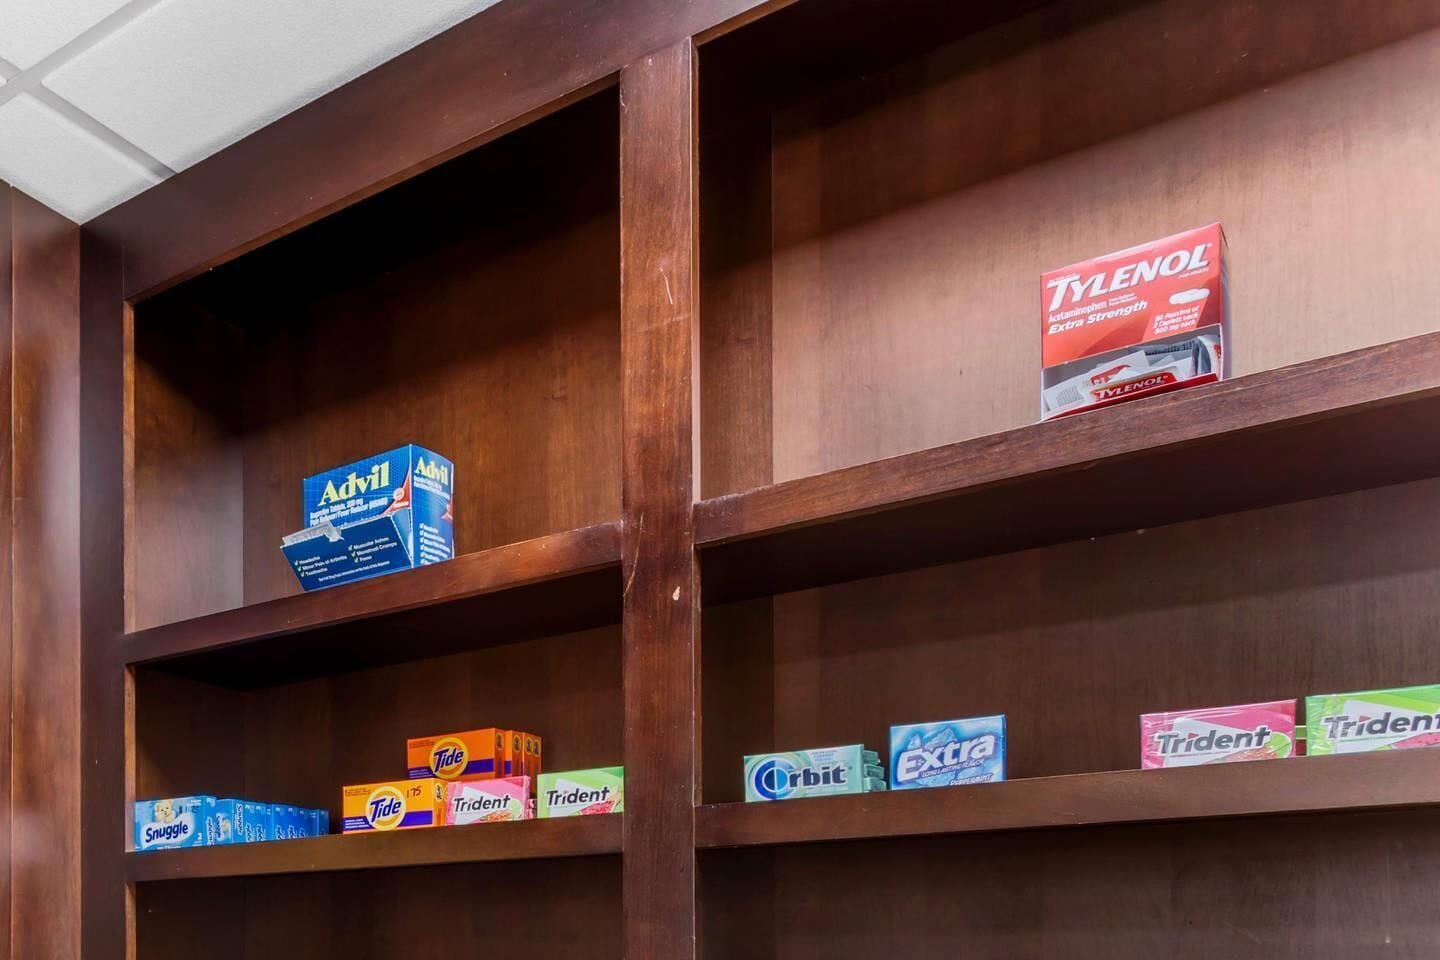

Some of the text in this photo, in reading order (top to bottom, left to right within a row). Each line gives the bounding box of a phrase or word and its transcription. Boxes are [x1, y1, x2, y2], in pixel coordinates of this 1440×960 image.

[1046, 243, 1210, 313] TYLENOL
[1048, 300, 1108, 323] Acetaminophen
[1048, 319, 1085, 335] Extra
[1087, 299, 1148, 325] Strength
[1164, 307, 1192, 319] Pouches
[1182, 312, 1199, 322] each
[1154, 326, 1169, 335] 500
[1095, 374, 1168, 400] TYLENOL
[414, 455, 449, 485] Advil
[317, 460, 390, 507] Advil
[1157, 727, 1271, 754] Trident
[433, 748, 465, 771] Tide
[896, 733, 996, 783] Extra
[753, 756, 847, 800] Orbit
[453, 794, 511, 812] Trident
[546, 787, 611, 806] Trident
[370, 797, 402, 823] Tide
[145, 820, 189, 843] Snuggle
